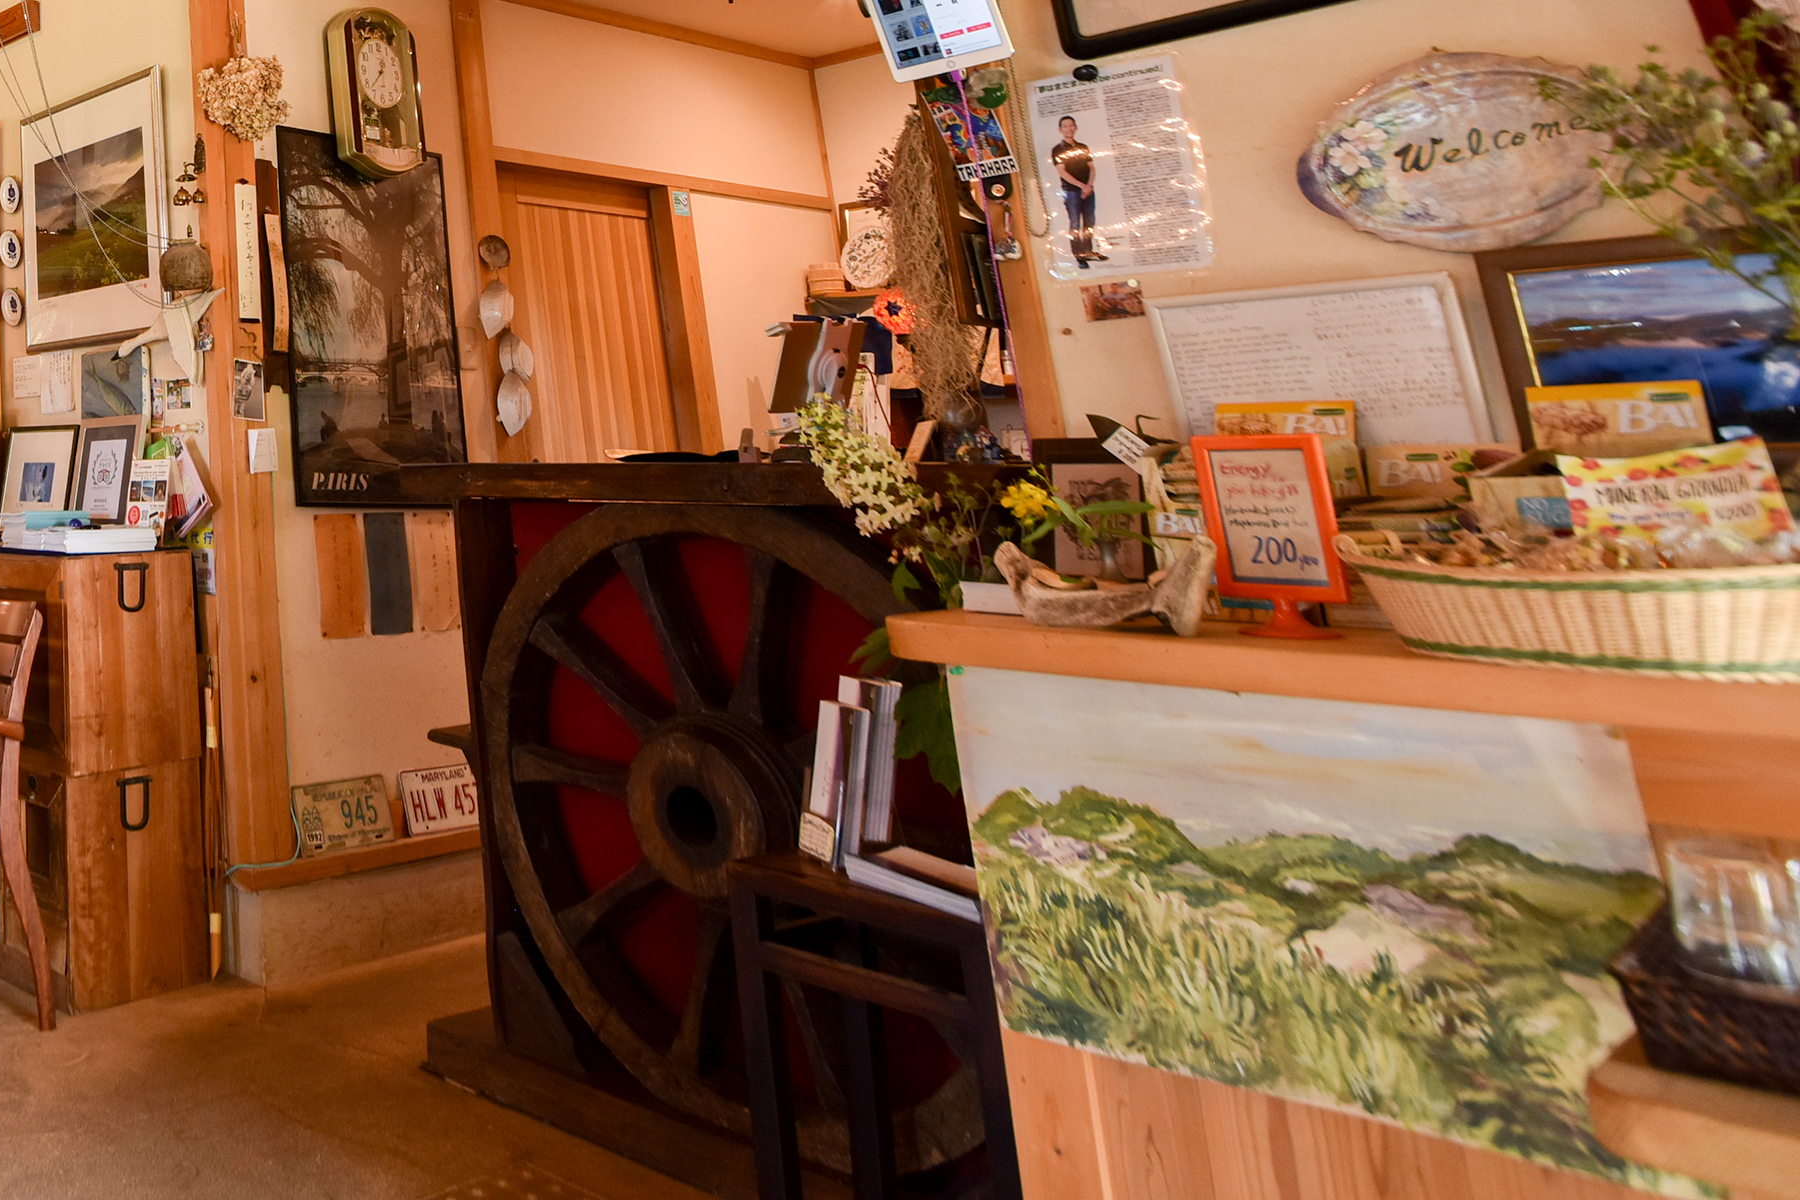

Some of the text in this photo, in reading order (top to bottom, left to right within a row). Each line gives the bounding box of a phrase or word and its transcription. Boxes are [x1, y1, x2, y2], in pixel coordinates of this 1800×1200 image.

[1394, 115, 1602, 173] Welcome
[1618, 400, 1699, 435] BA!
[311, 471, 370, 491] PARIS
[1379, 458, 1444, 488] BA!
[1156, 512, 1203, 536] BA!
[1250, 534, 1298, 566] 200
[420, 767, 466, 783] MARYLAND
[340, 794, 379, 830] 945
[409, 781, 477, 824] HLW 45
[306, 830, 323, 843] 1992
